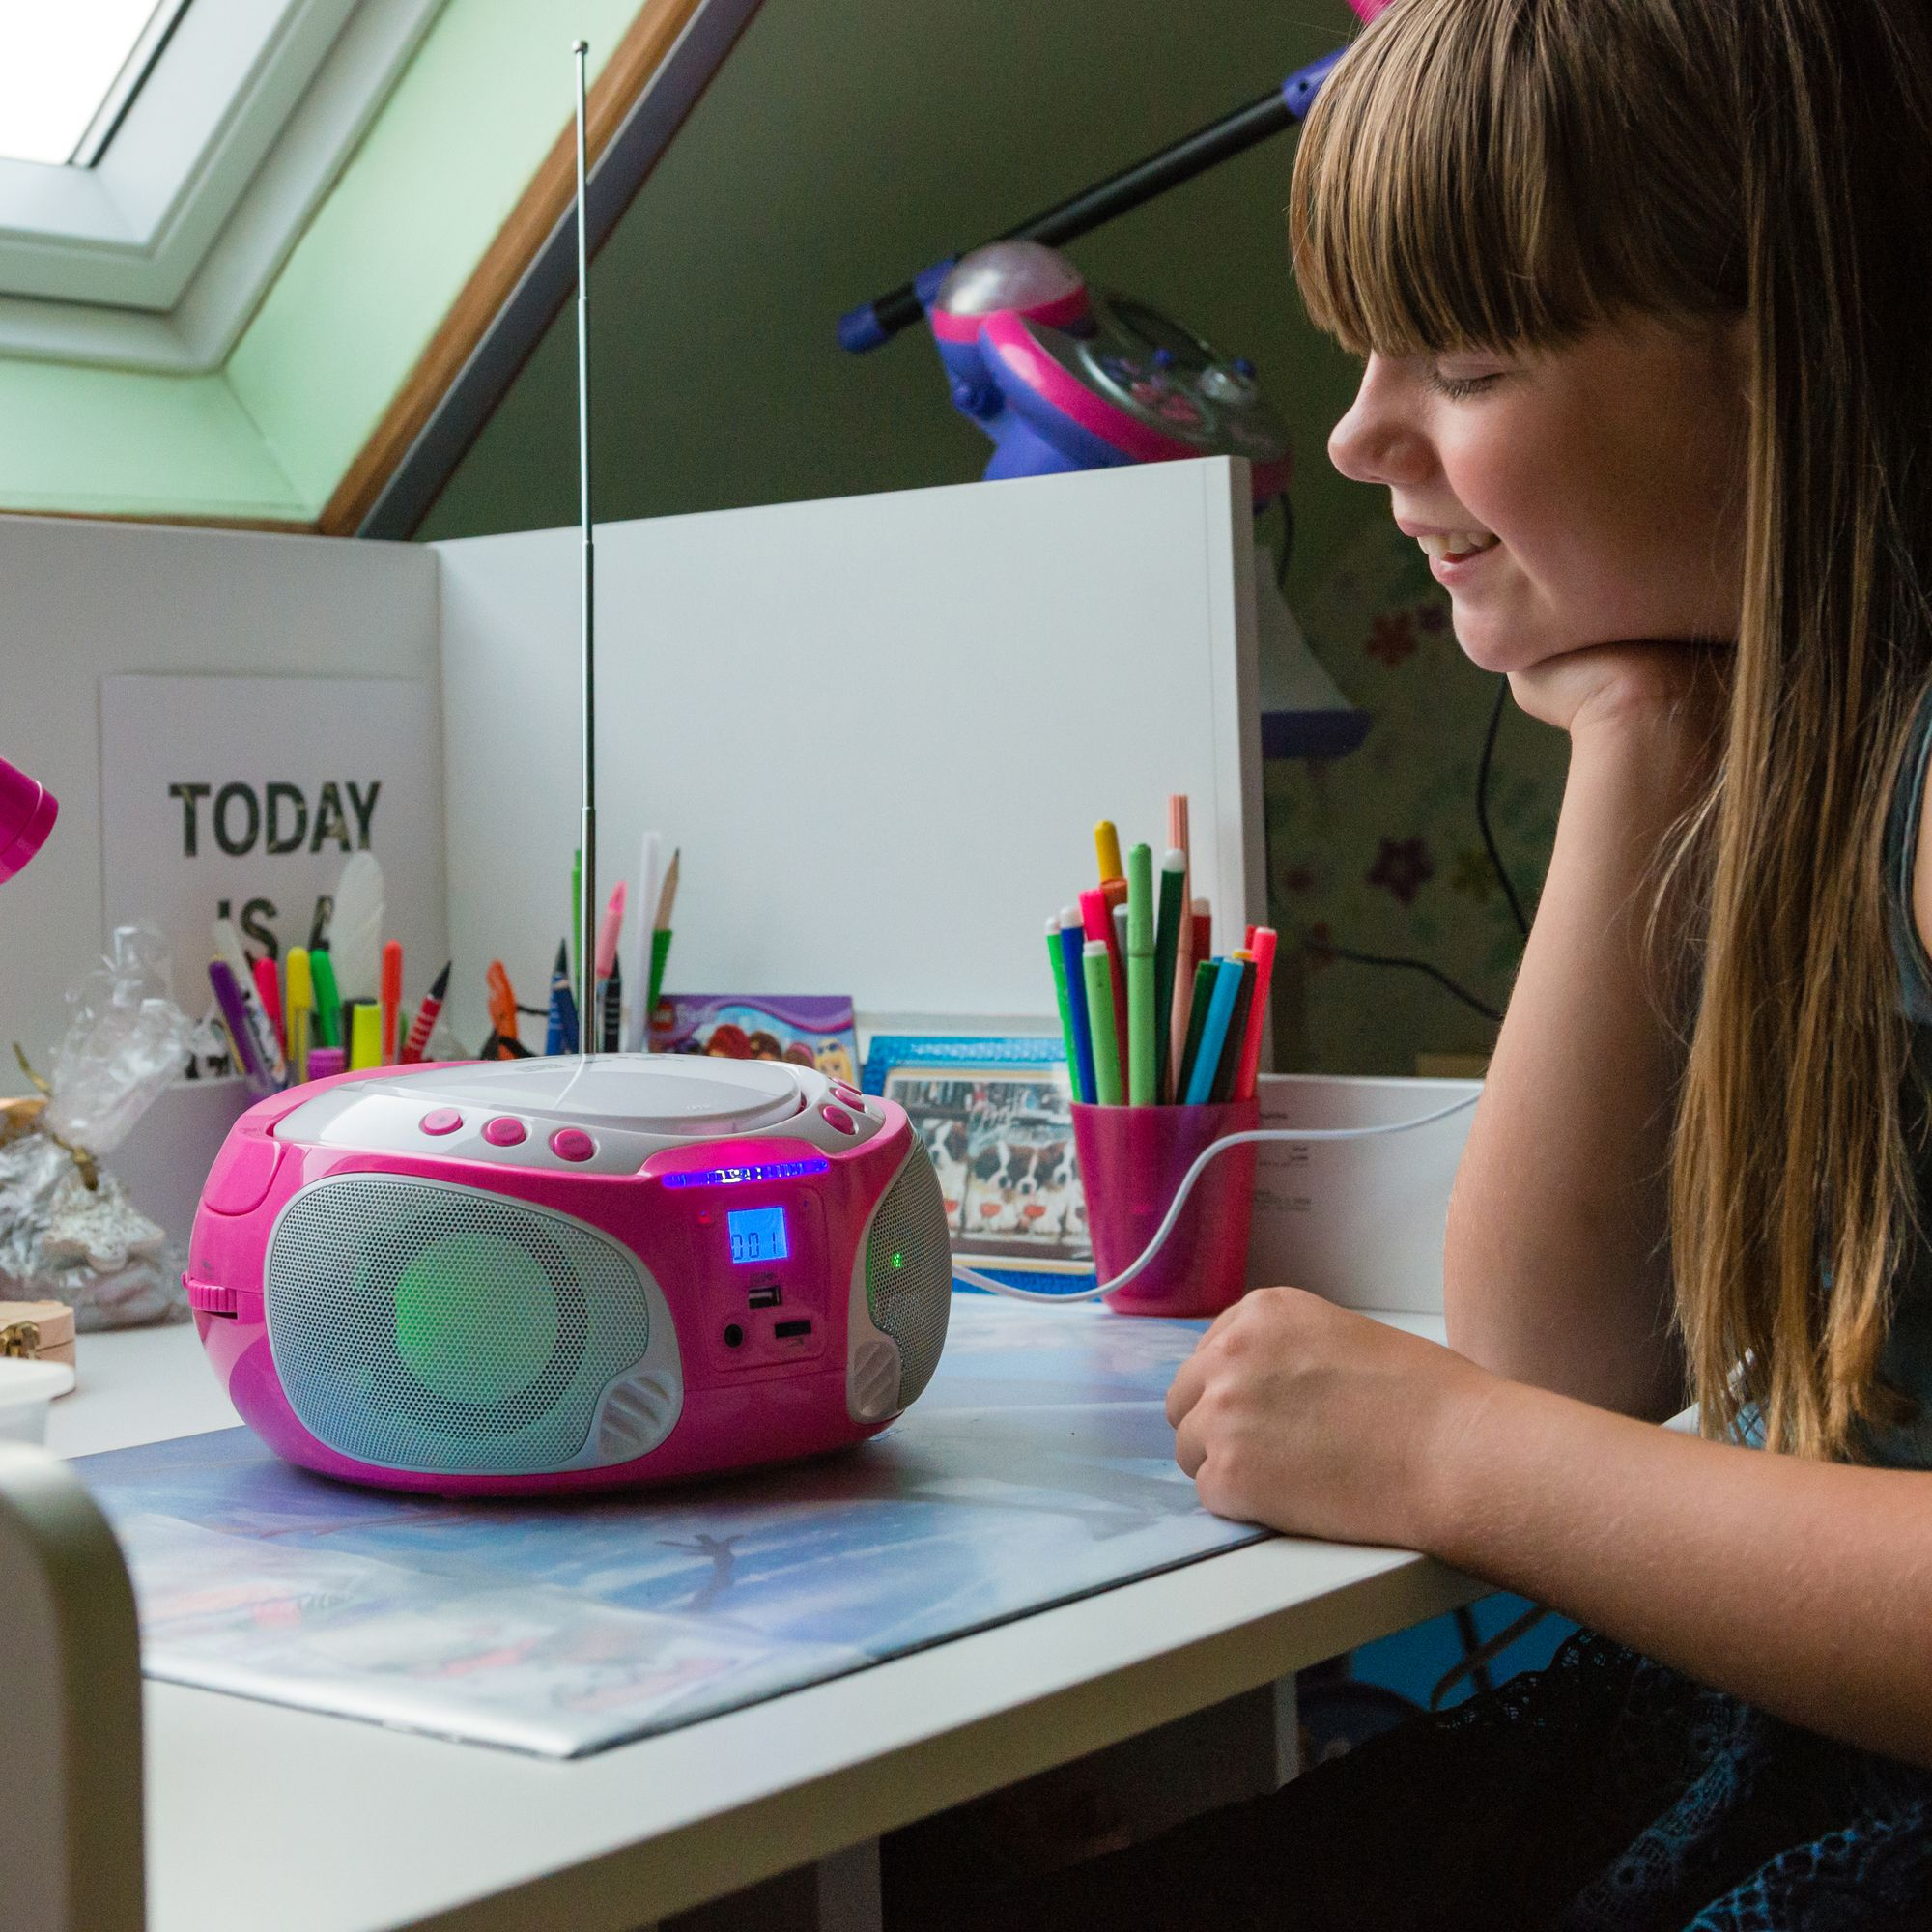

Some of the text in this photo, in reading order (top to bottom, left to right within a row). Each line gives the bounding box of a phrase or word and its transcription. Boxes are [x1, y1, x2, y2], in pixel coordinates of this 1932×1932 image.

[168, 781, 382, 857] TODAY
[218, 897, 278, 972] S
[731, 1232, 777, 1260] 001
